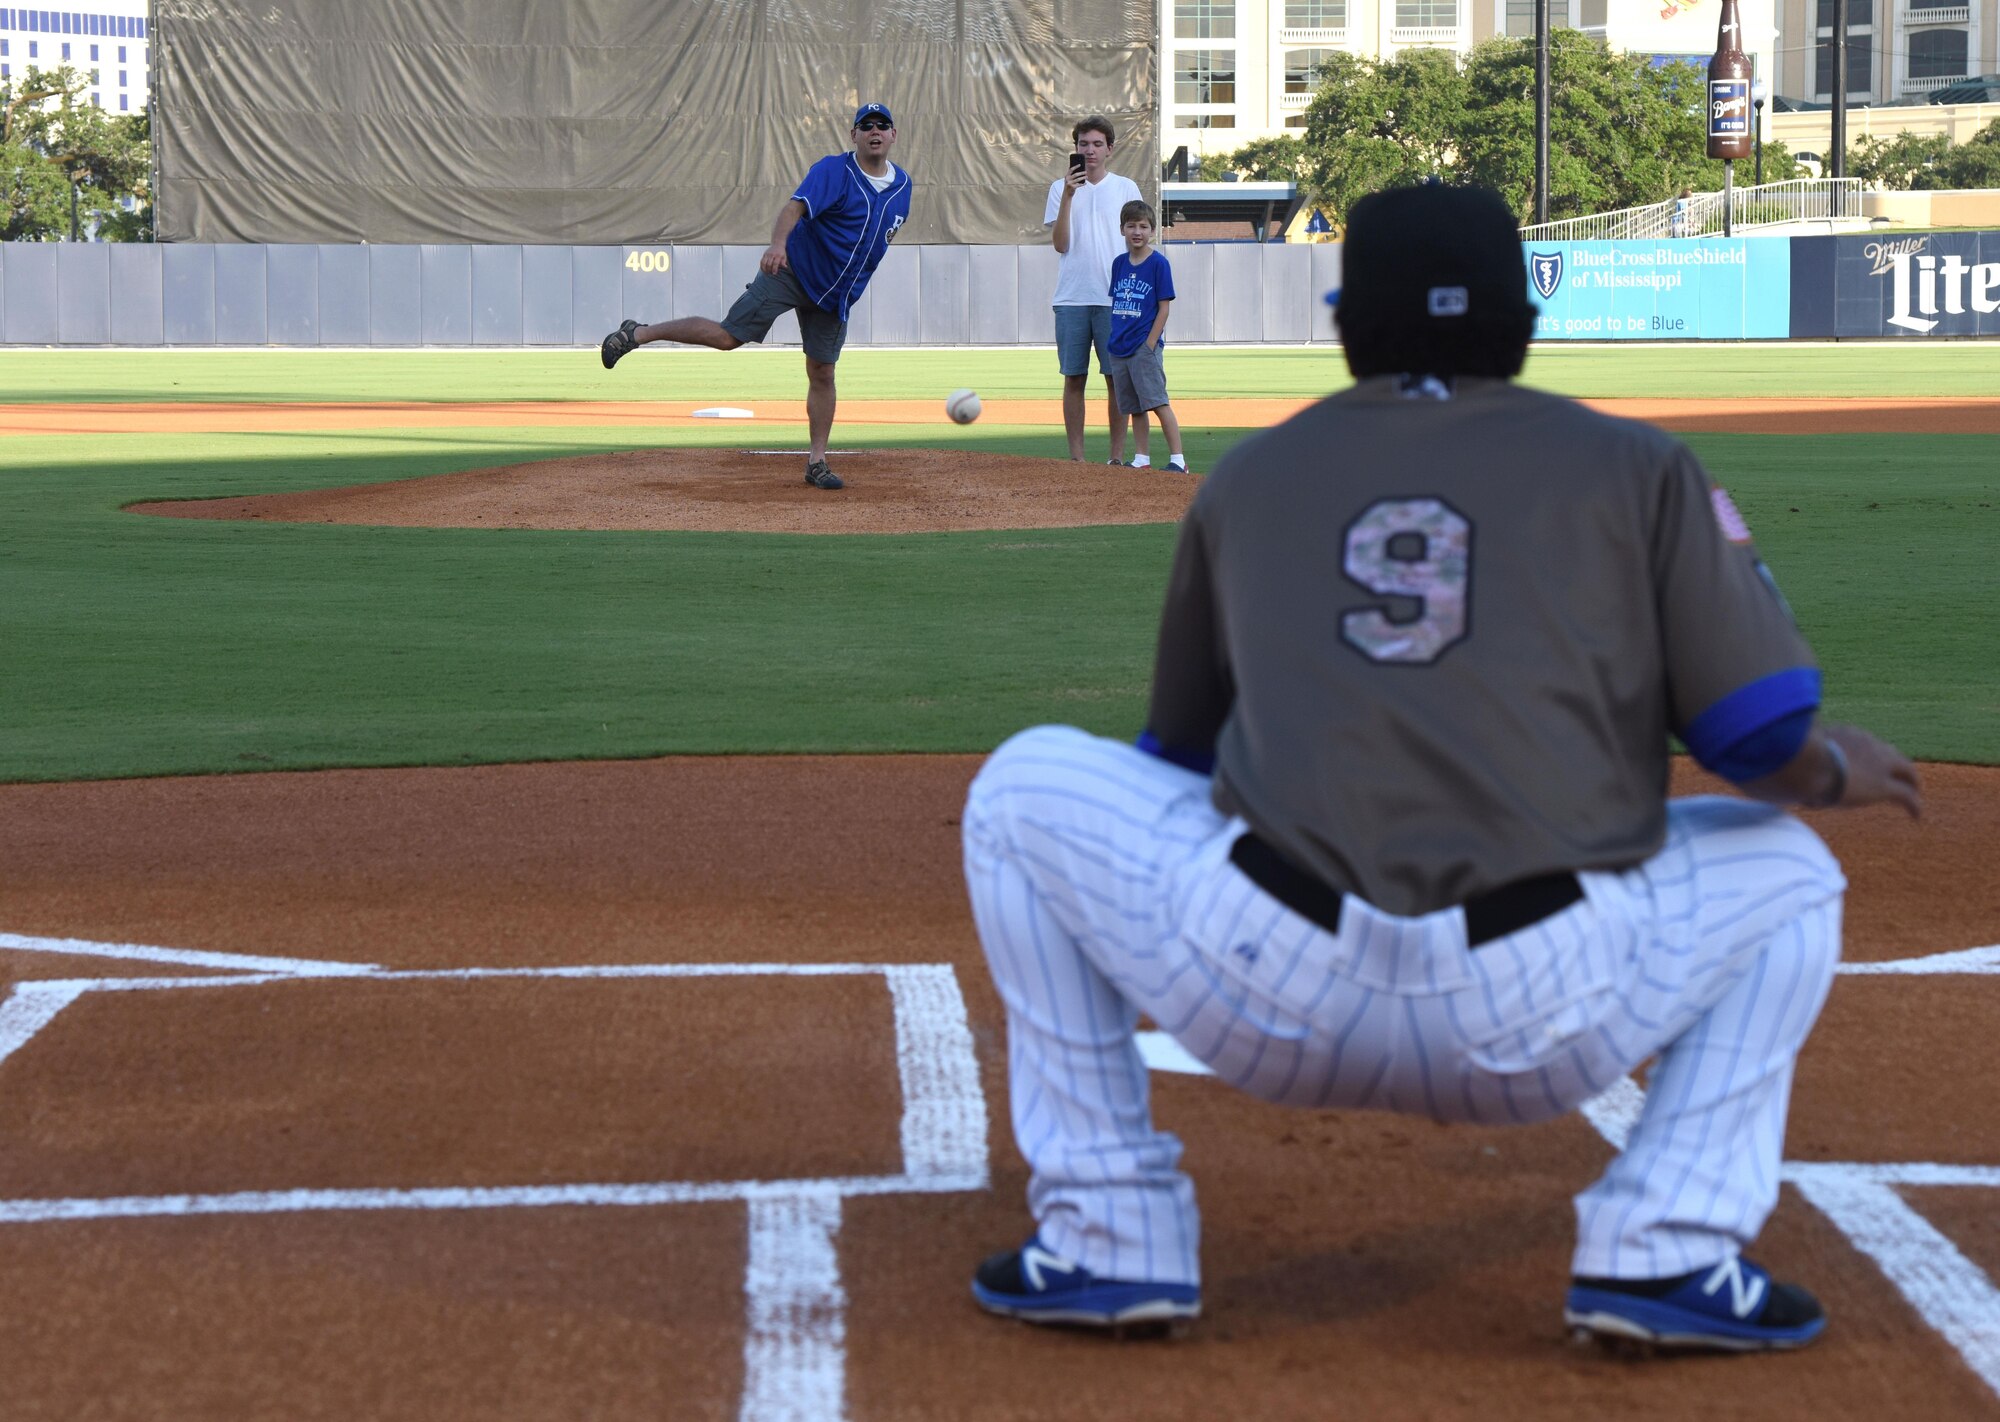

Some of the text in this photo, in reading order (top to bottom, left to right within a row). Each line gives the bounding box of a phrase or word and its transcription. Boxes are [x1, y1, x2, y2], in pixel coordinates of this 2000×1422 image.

[625, 251, 670, 272] 400
[1572, 246, 1746, 267] BlueCross BlueShield
[1864, 236, 1929, 272] Miller
[1135, 280, 1153, 295] CITY
[1572, 270, 1682, 291] of Mississippi
[1886, 253, 2000, 333] Lite
[1537, 316, 1560, 331] It's
[1565, 315, 1602, 334] good
[1607, 317, 1622, 331] to
[1627, 315, 1646, 331] be
[1338, 495, 1474, 667] 9
